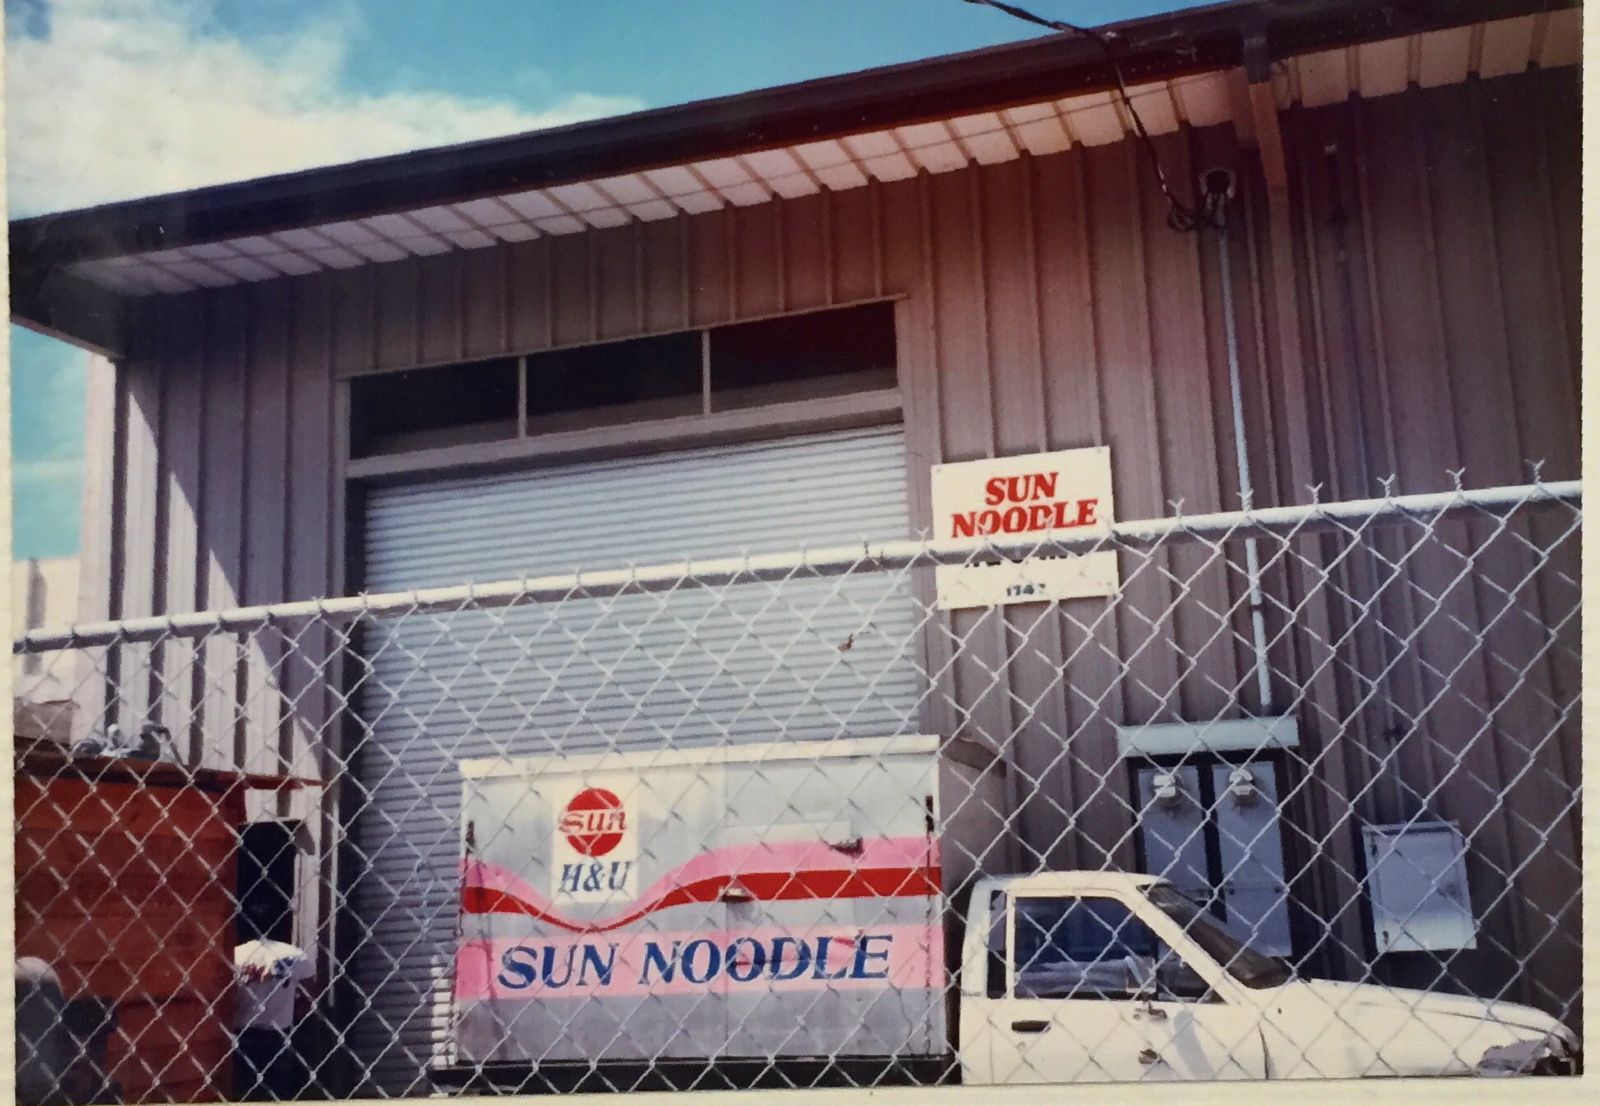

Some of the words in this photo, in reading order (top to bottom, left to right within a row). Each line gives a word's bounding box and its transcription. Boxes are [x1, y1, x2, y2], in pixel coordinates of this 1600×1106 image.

[985, 472, 1059, 506] SUN
[951, 498, 1098, 539] NOODLE
[558, 861, 631, 892] H&U
[497, 942, 620, 990] SUN
[638, 933, 894, 985] NOODLE
